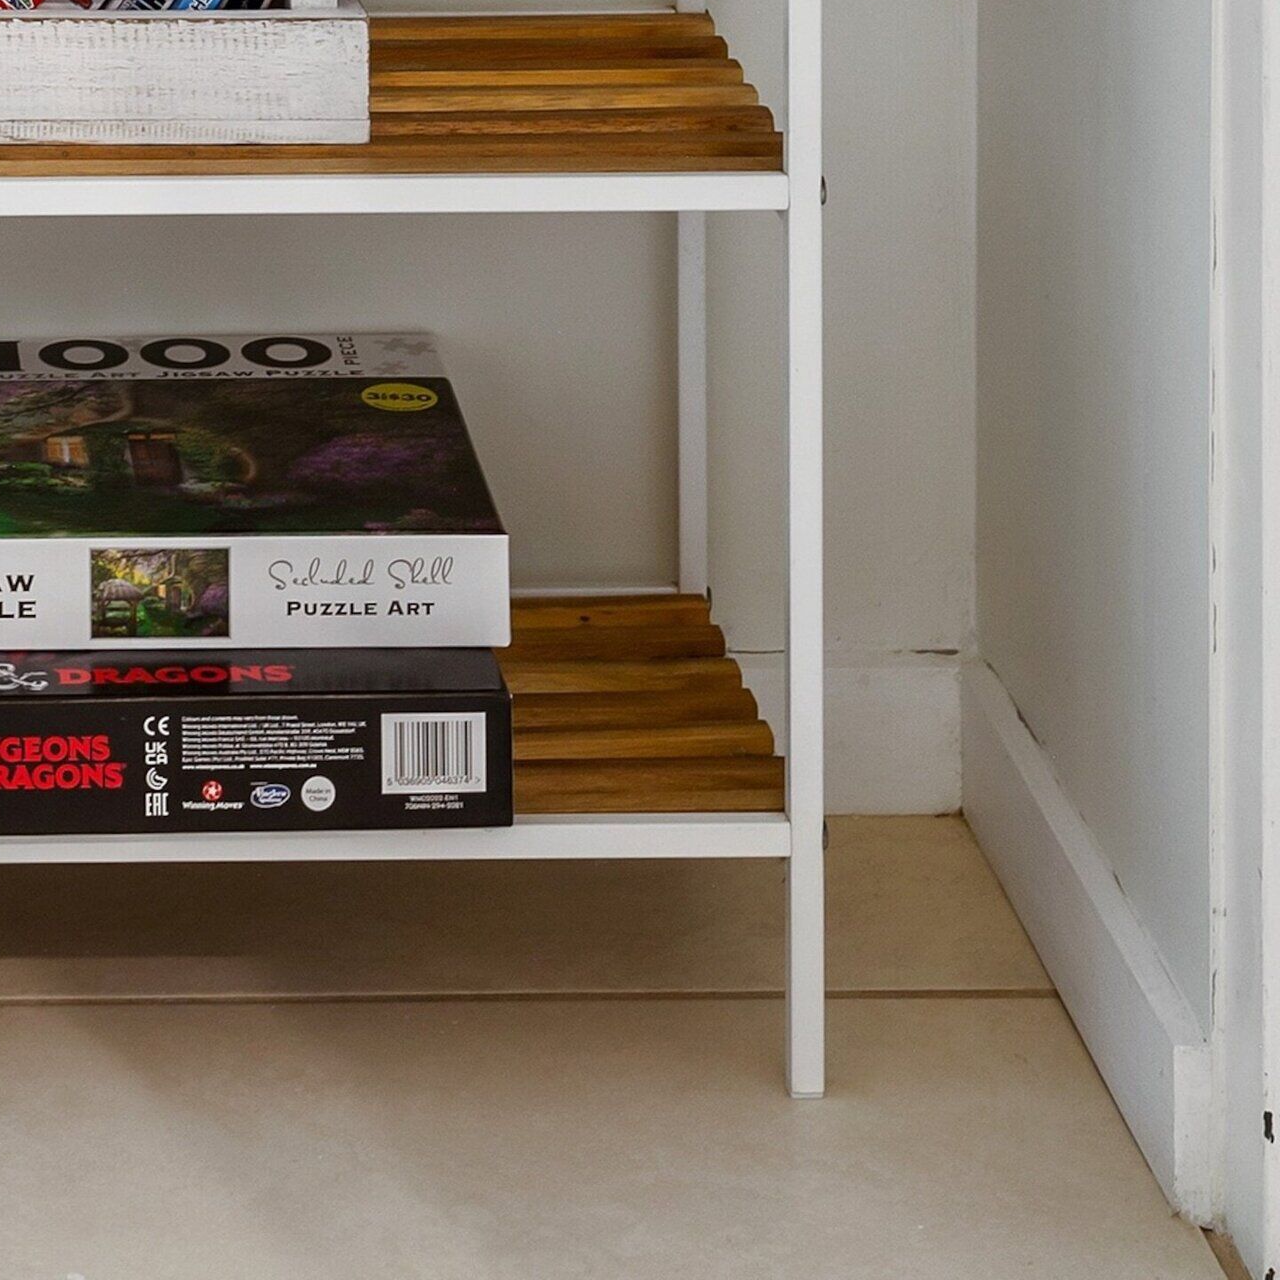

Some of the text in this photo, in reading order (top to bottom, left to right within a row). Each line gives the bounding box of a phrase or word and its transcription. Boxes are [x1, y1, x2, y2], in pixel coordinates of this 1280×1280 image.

[337, 336, 360, 366] PIECE
[155, 370, 255, 378] JIGSAW
[265, 369, 365, 377] PUZZLE
[268, 555, 454, 591] Secluded Shell
[286, 601, 435, 616] PUZZLE ART
[54, 665, 293, 685] DRAGONS
[145, 741, 167, 753] UK
[145, 754, 168, 765] CA
